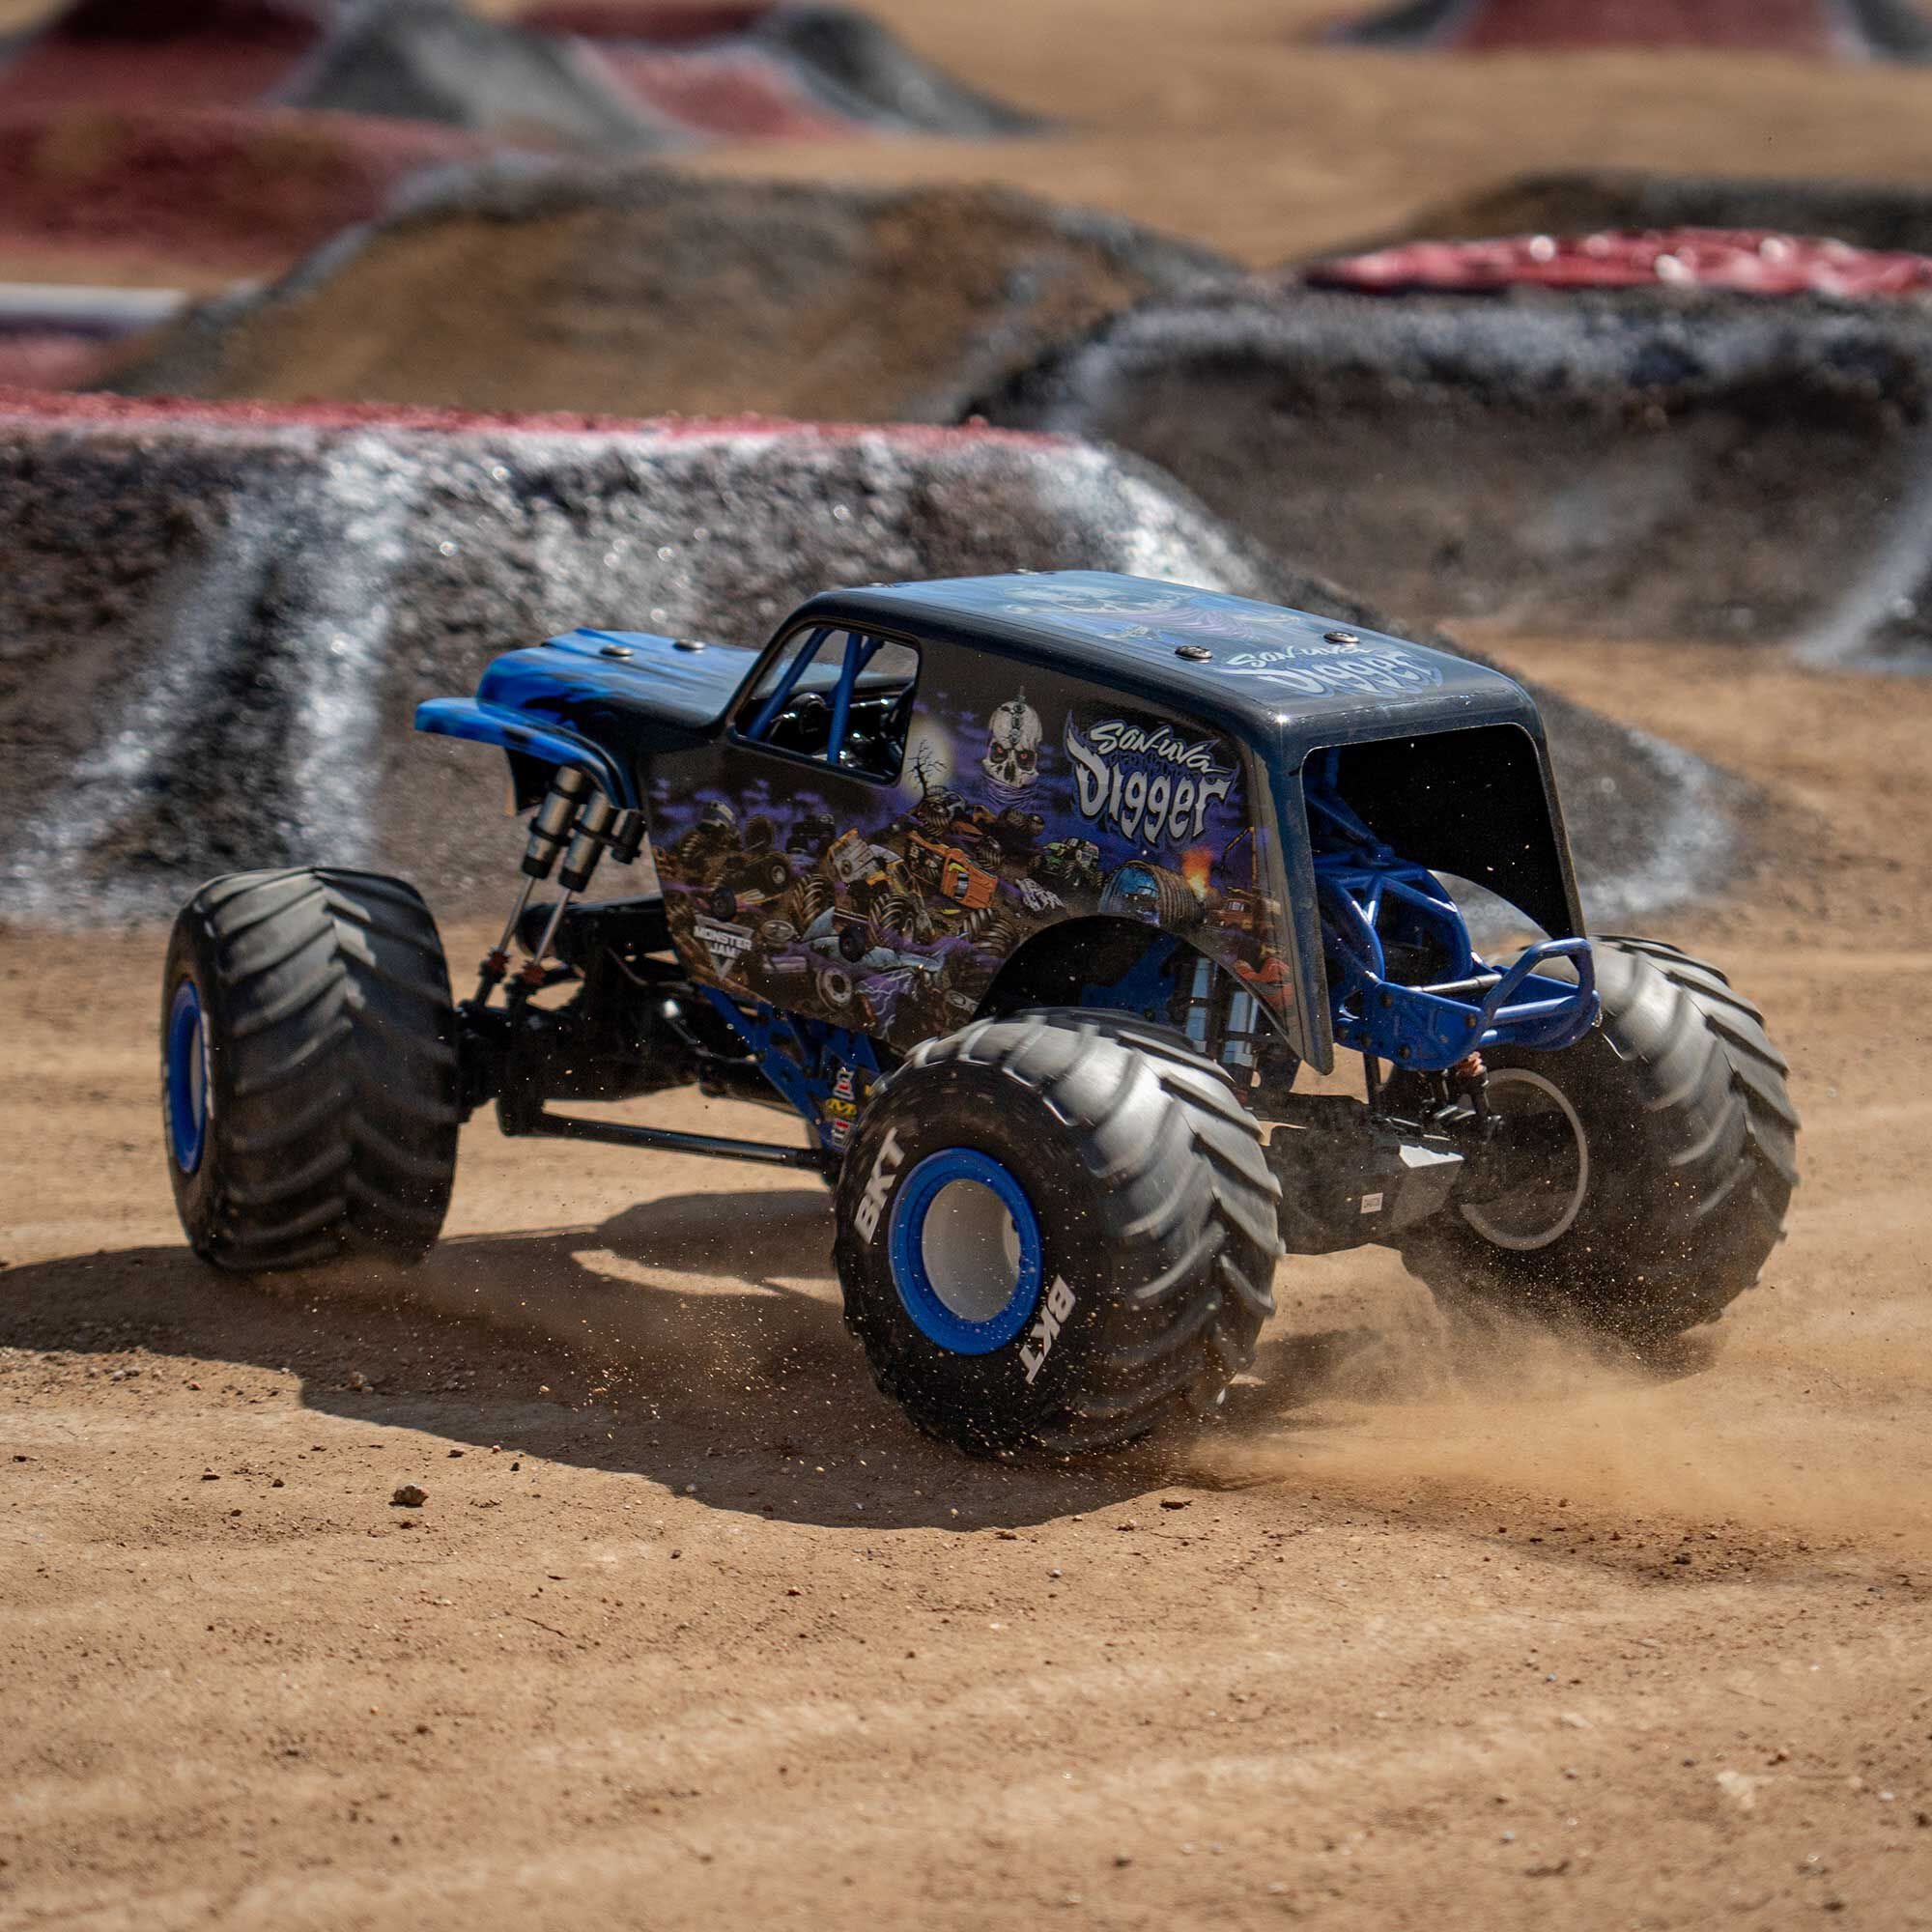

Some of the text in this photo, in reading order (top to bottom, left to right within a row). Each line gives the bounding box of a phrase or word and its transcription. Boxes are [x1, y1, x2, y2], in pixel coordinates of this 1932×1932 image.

[1066, 727, 1233, 844] Digger
[694, 924, 753, 952] MONSTER
[709, 942, 742, 960] JAM
[853, 1126, 906, 1244] BKT
[1019, 1273, 1076, 1384] BKT
